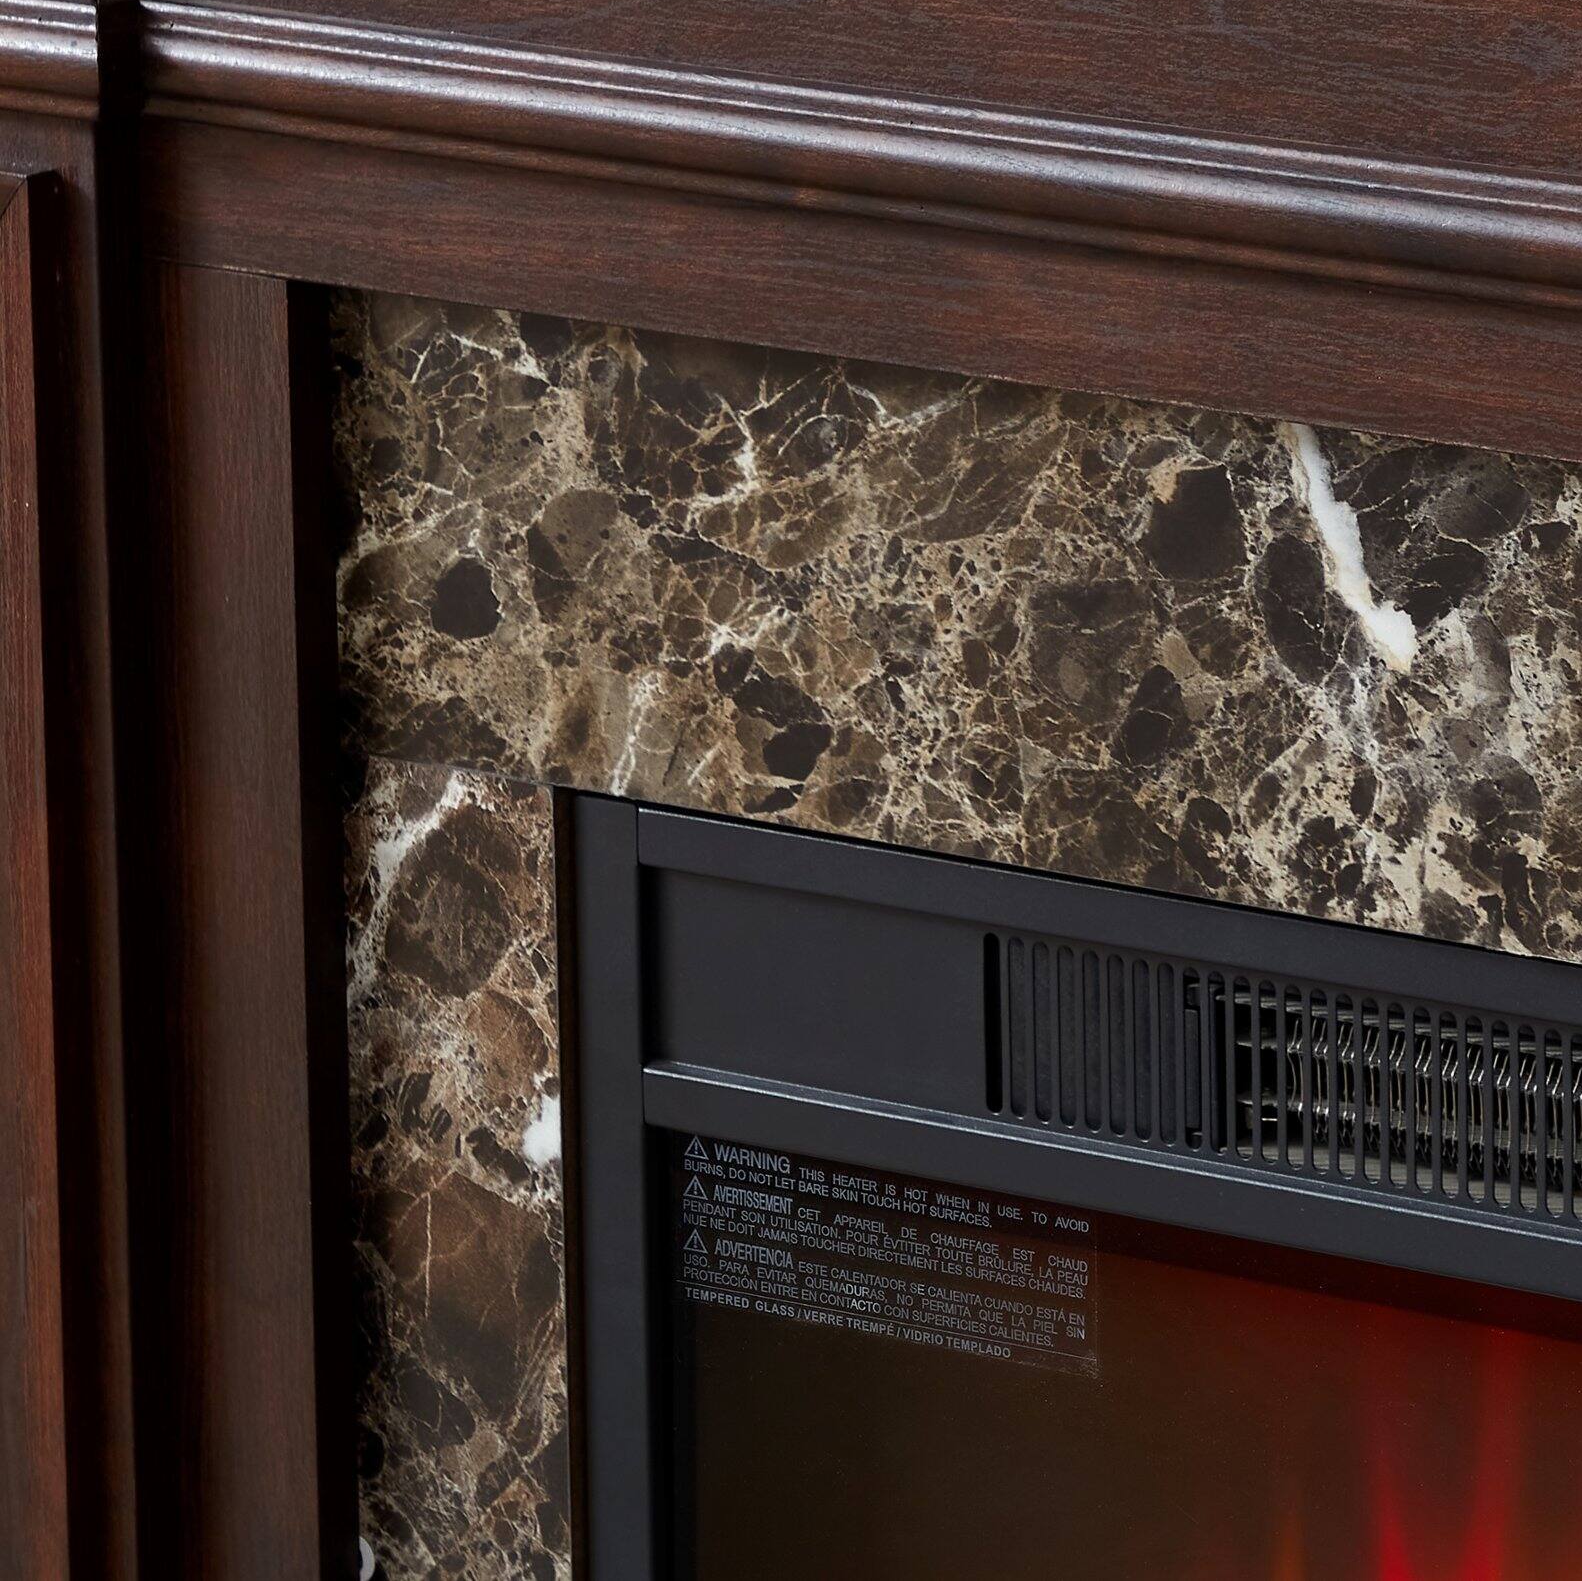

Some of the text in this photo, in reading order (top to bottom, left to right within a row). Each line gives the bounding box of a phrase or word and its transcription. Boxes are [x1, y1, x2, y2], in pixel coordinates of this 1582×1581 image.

[684, 1159, 992, 1228] BURNS, DO NOT LET BARE SKIN TOUCH HOT SURFACES.
[713, 1184, 1088, 1273] AVERTISSEMENT CET APPAREIL DE CHAUFFAGE EST CHAUD
[714, 1143, 1089, 1233] WARNING THIS HEATER IS HOT WHEN IN USE. TO AVOID
[683, 1198, 736, 1218] PENDANT
[741, 1210, 765, 1224] SON
[770, 1216, 841, 1239] UTILISATION.
[846, 1230, 878, 1246] POUR
[935, 1247, 973, 1265] TOUTE
[1039, 1267, 1053, 1279] LA
[1057, 1271, 1088, 1286] PEAU
[683, 1212, 1086, 1300] NUE NE DOIT JAMAIS TOUCHER DIRECTEMENT LES SURFACES CHAUDES.
[715, 1238, 793, 1269] ADVERTENCIA
[799, 1261, 828, 1277] ESTE
[831, 1268, 906, 1292] CALENTADOR
[910, 1282, 925, 1295] SE
[928, 1286, 982, 1306] CALIENTA
[985, 1297, 1033, 1317] CUANDO
[1069, 1313, 1085, 1326] EN
[683, 1253, 710, 1268] USO.
[719, 1260, 749, 1276] PARA
[757, 1267, 797, 1284] EVITAR
[896, 1292, 914, 1307] NO
[921, 1298, 971, 1318] PERMITA
[979, 1309, 1003, 1324] QUE
[1011, 1316, 1026, 1328] LA
[1033, 1320, 1058, 1335] PIEL
[1066, 1326, 1085, 1340] SIN
[683, 1268, 1054, 1348] PROTECCIÓN ENTRE EN CONTACTO CON SUPERFICIES CALIENTES.
[685, 1287, 749, 1309] TEMPERED
[755, 1300, 795, 1318] GLASS
[803, 1309, 843, 1327] VERRE
[846, 1317, 894, 1336] TREMPÉ
[903, 1328, 944, 1346] VIDRIO
[946, 1336, 1011, 1358] TEMPLADO
